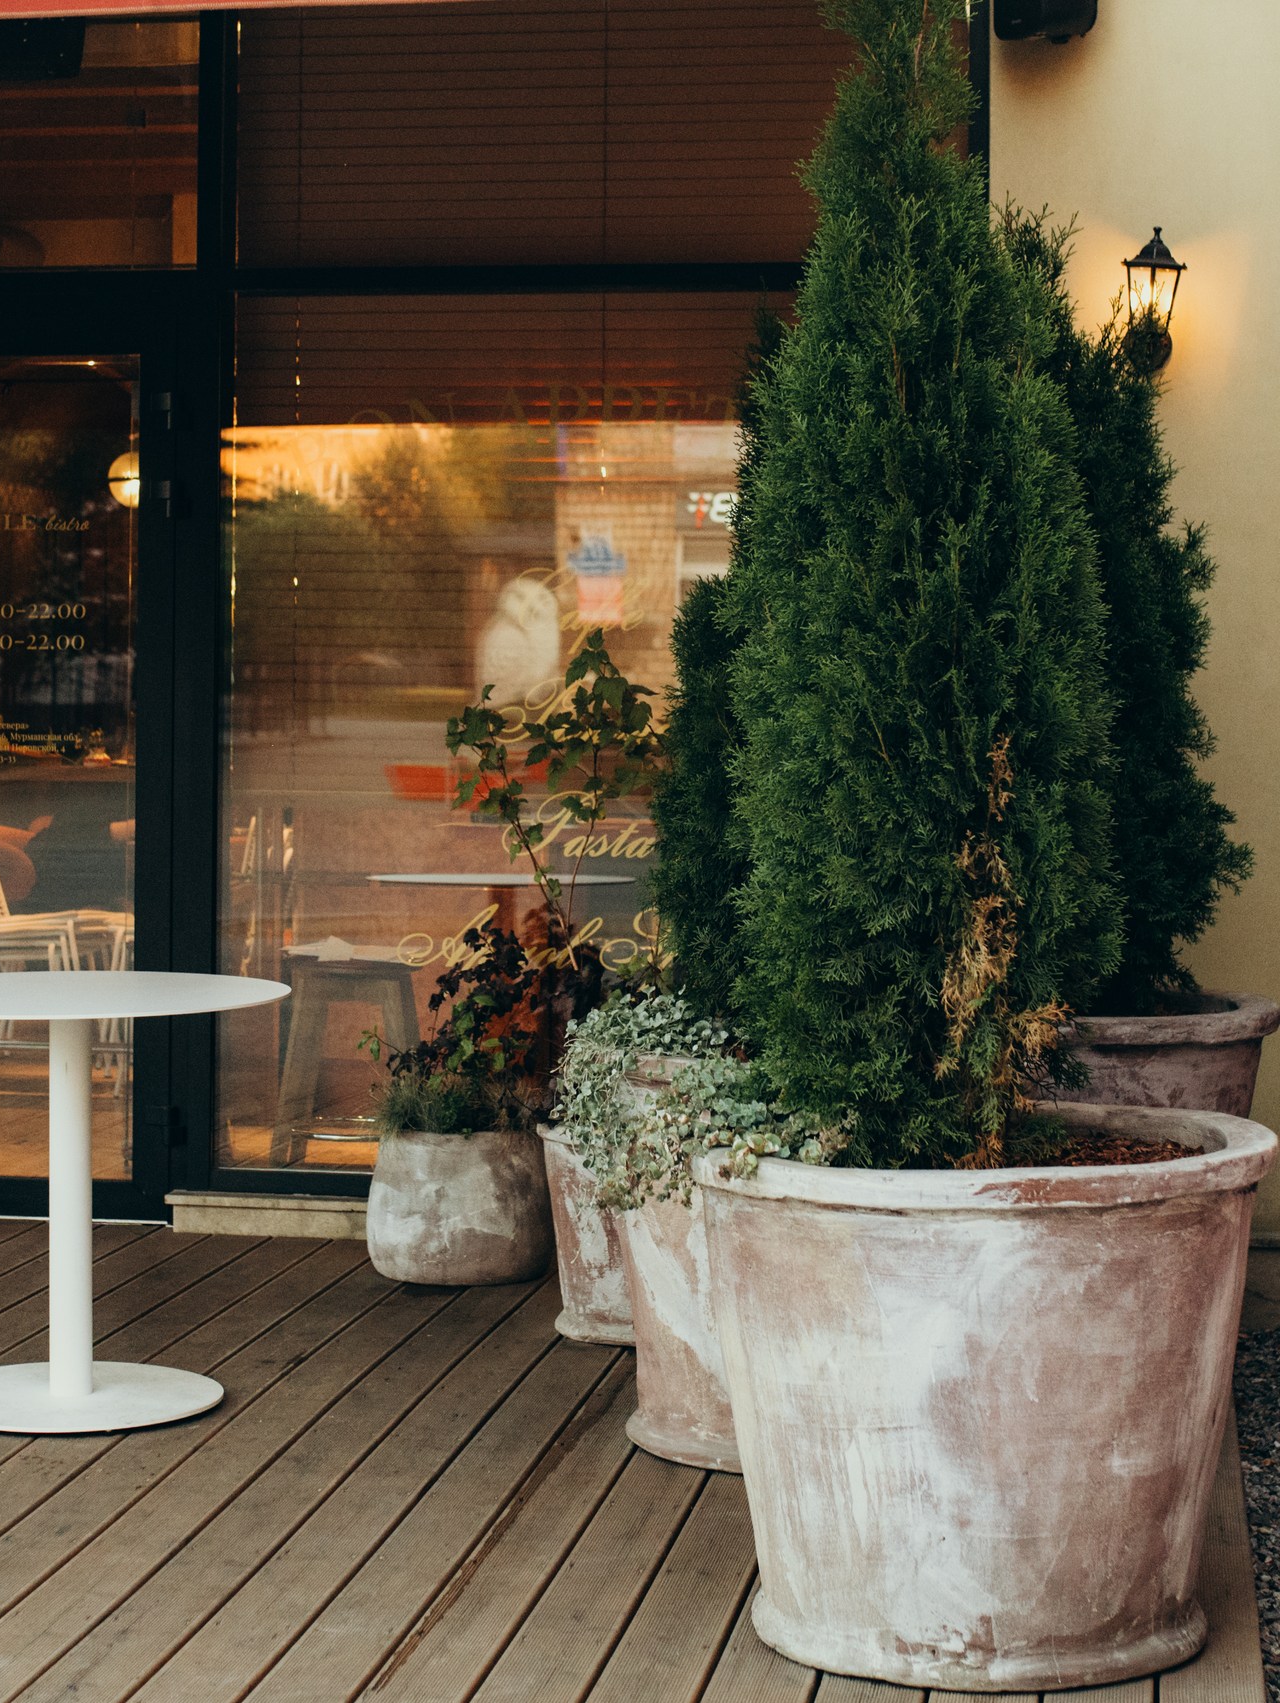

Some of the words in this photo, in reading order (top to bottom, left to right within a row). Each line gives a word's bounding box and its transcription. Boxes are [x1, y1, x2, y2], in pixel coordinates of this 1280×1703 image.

[45, 513, 91, 532] bistro
[10, 731, 62, 742] Мурманская
[502, 790, 657, 858] Pasta
